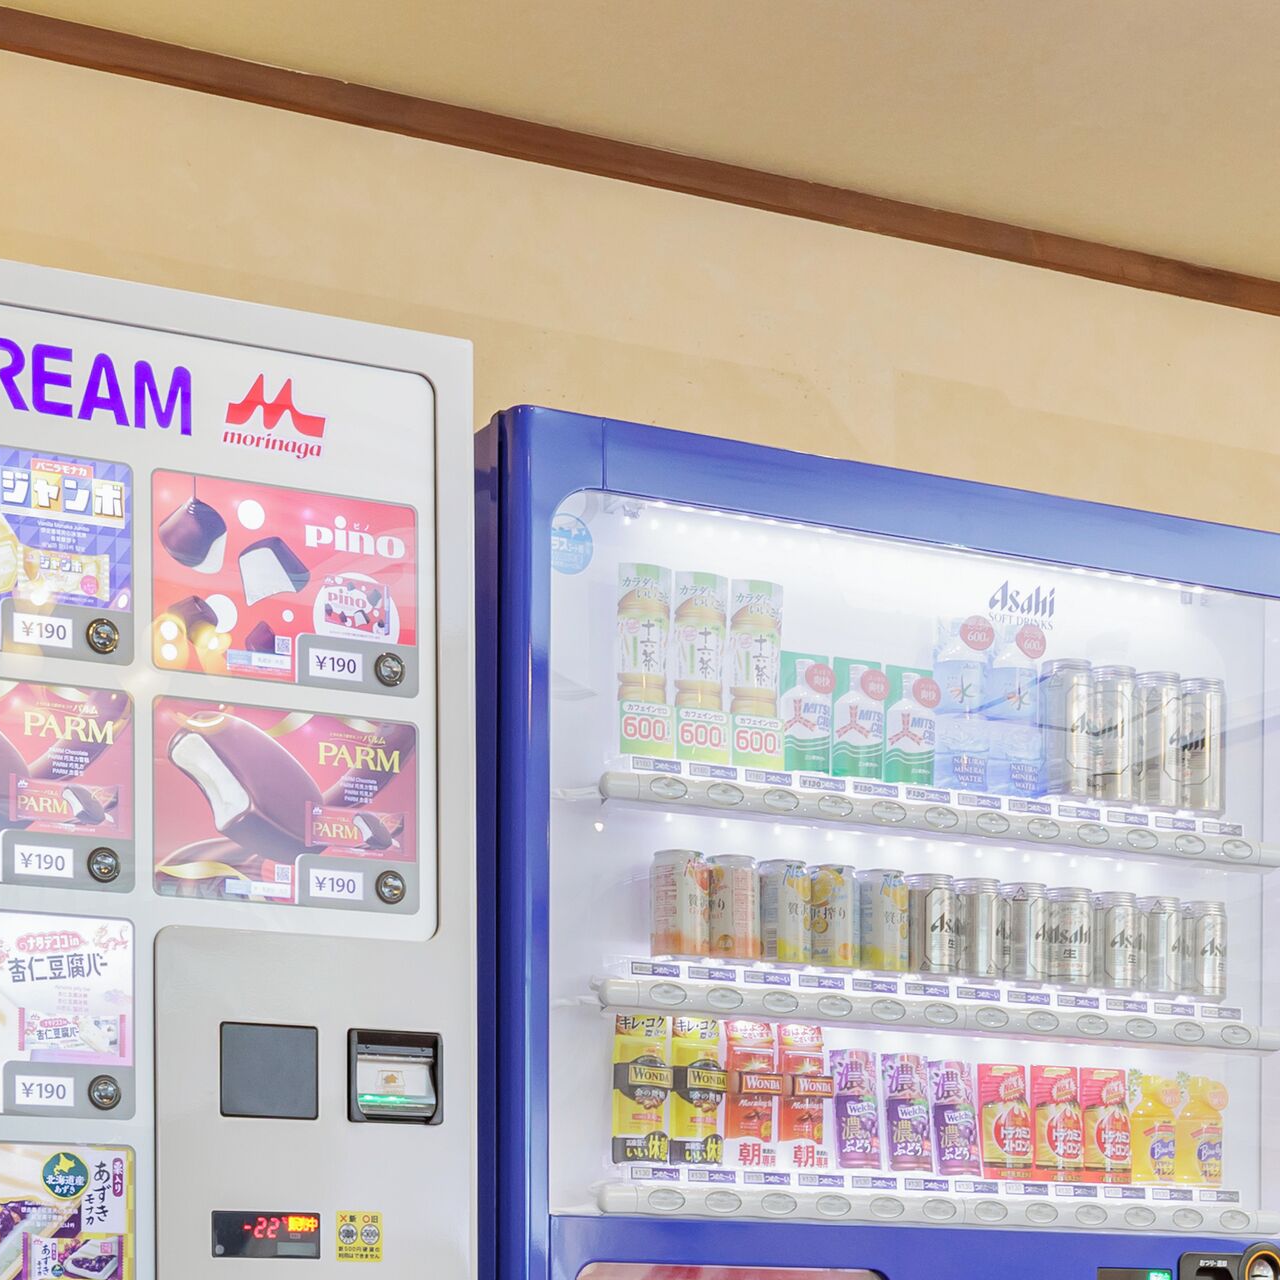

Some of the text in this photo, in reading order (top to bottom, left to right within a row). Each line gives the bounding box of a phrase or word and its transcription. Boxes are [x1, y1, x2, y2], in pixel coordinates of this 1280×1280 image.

[223, 431, 322, 459] morinaga
[35, 461, 87, 477] バニラモナカ
[2, 470, 123, 517] ジャンボ
[305, 515, 405, 558] pino
[327, 590, 367, 609] pino
[989, 580, 1055, 618] Asahi
[21, 621, 66, 640] ¥190
[989, 611, 1054, 631] SOFT DRINKS
[640, 619, 658, 672] 十六茶
[968, 631, 986, 642] 600
[1024, 639, 1040, 651] 600
[697, 628, 715, 680] 十六茶
[753, 635, 770, 686] 十六茶
[315, 655, 357, 674] ¥190
[24, 712, 114, 745] PARM
[623, 716, 666, 741] 600
[680, 723, 722, 747] 600
[736, 729, 776, 753] 600
[318, 742, 401, 774] PARM
[18, 796, 68, 814] PARM
[312, 822, 358, 840] PARM
[20, 852, 66, 870] ¥190
[316, 876, 356, 893] ¥190
[8, 952, 108, 982] 杏仁豆腐バー
[633, 1068, 670, 1082] WONDA
[692, 1070, 726, 1085] WONDA
[745, 1079, 781, 1090] WONDA
[22, 1082, 66, 1100] ¥190
[799, 1081, 832, 1092] WONDA
[739, 1143, 761, 1166] 朝
[843, 1139, 870, 1153] ぶどう
[894, 1142, 922, 1156] ぶどう
[942, 1148, 970, 1161] ぶどう
[793, 1145, 815, 1167] 朝
[46, 1175, 86, 1186] 北海道産
[54, 1185, 76, 1194] あずき
[94, 1161, 111, 1222] あずき
[85, 1194, 94, 1225] モナカ
